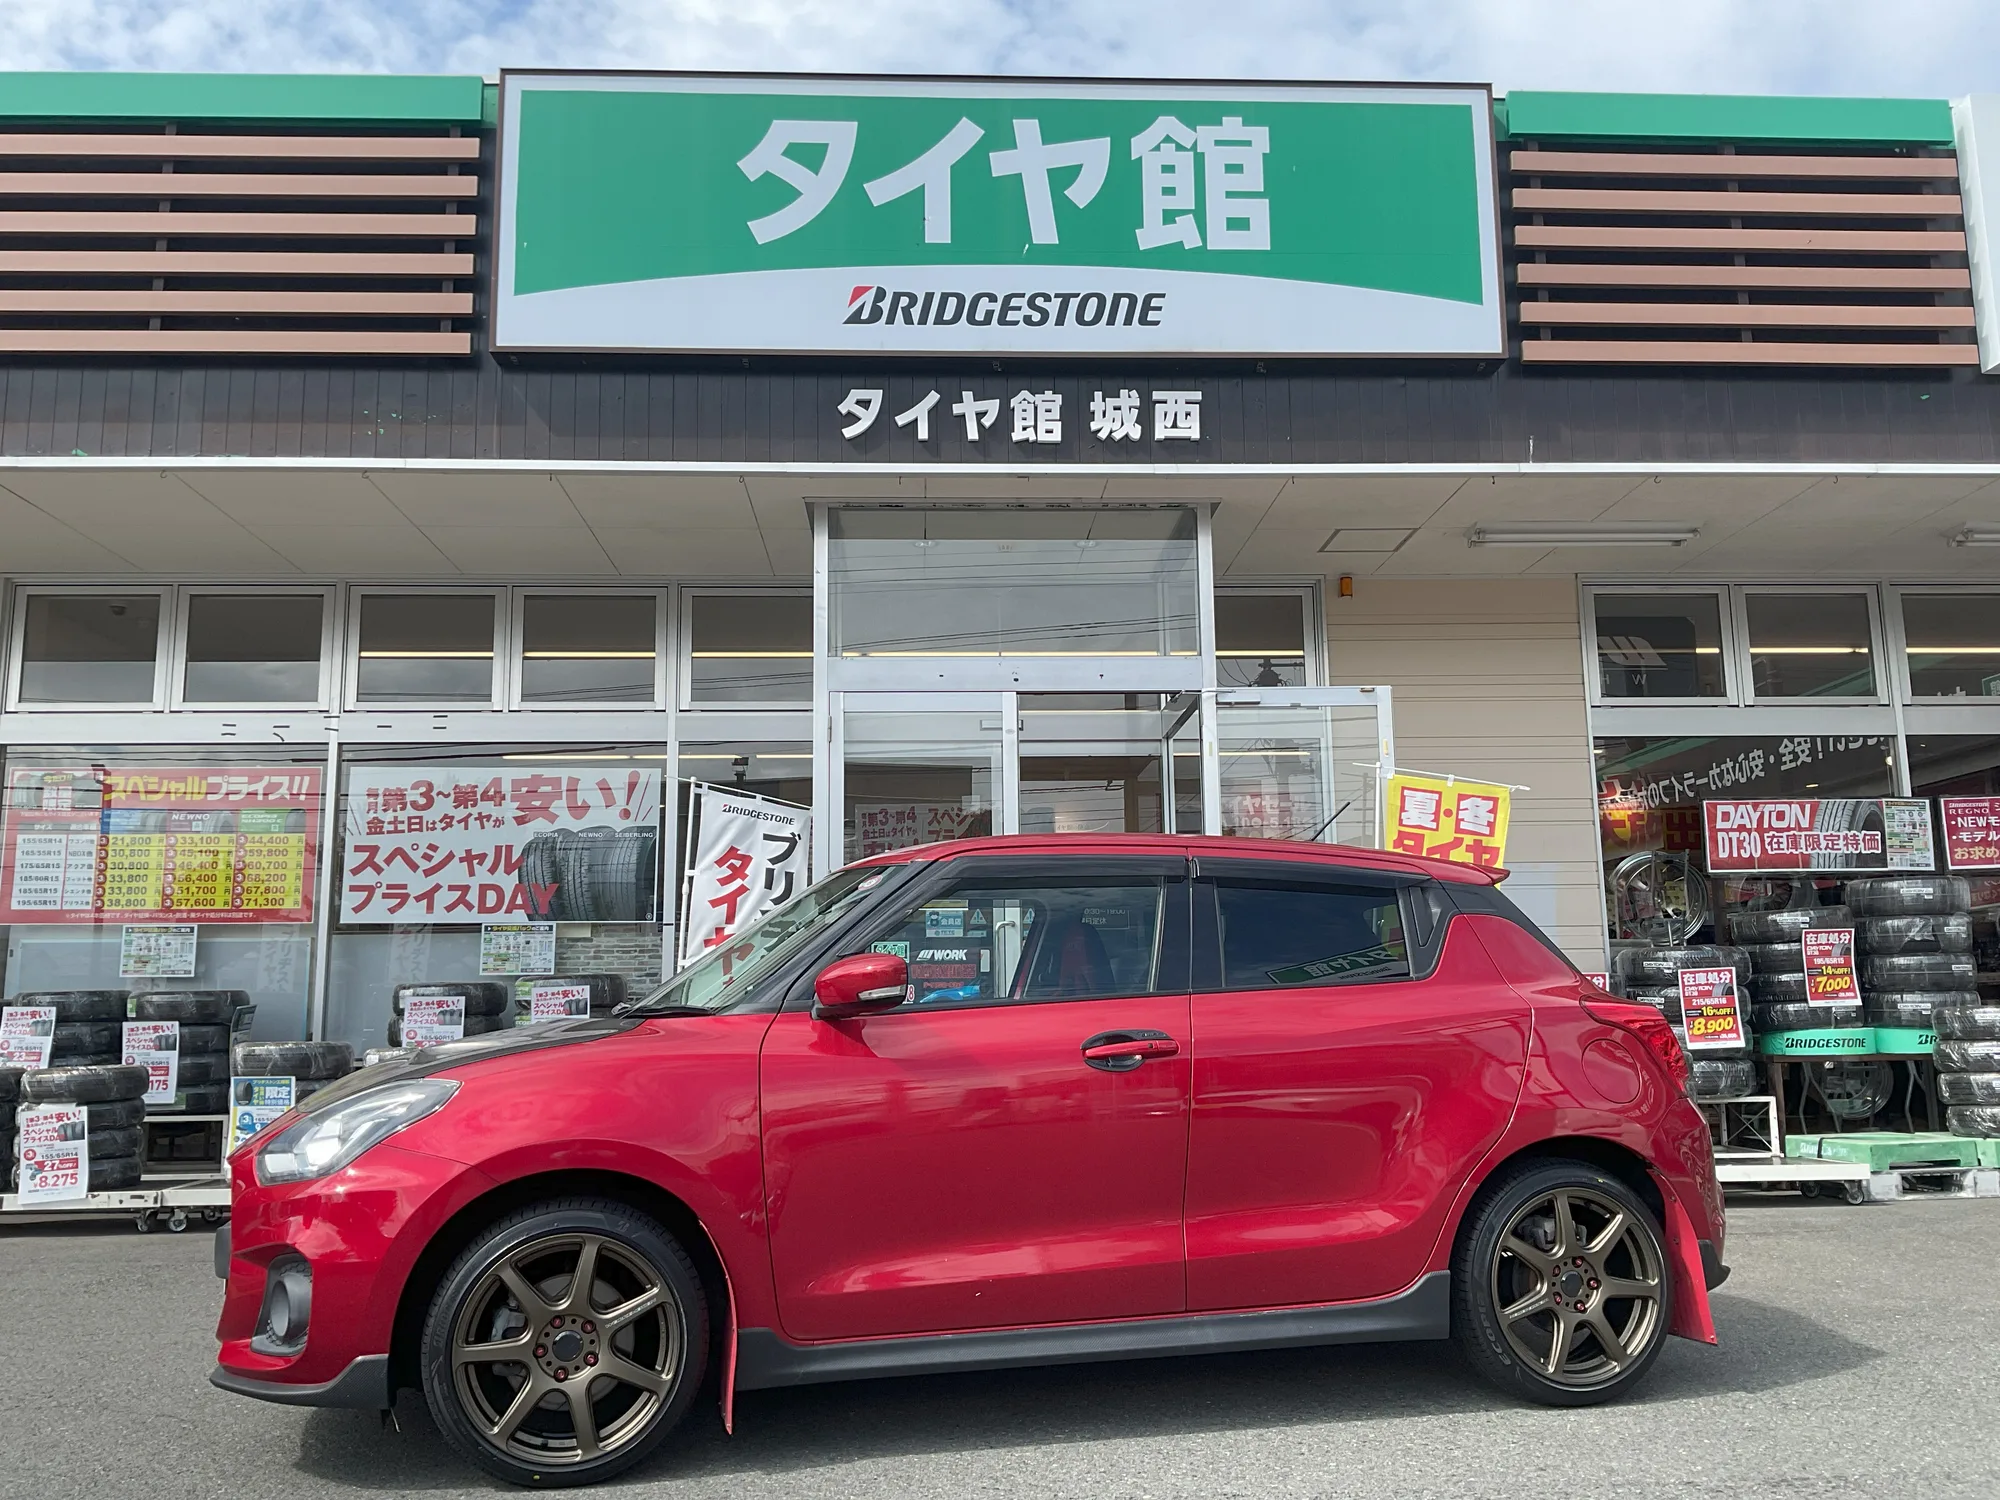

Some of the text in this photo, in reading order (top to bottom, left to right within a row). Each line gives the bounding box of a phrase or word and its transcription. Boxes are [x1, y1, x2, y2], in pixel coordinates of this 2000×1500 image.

[737, 114, 1271, 251] タイヤ館
[842, 285, 1166, 327] BRIDGESTONE
[837, 388, 1202, 443] タイヤ館 城西
[171, 813, 210, 821] NEWNO
[365, 811, 505, 836] 金土日はタイヤが
[722, 803, 795, 826] BRIDGESTONE
[1716, 804, 1810, 829] DAYTON
[1717, 831, 1761, 858] DT30
[1765, 831, 1882, 855] 在庫限定特価
[1954, 846, 2000, 860] お求め
[349, 842, 525, 878] スペシャル
[348, 881, 560, 915] プライスDAY
[1806, 932, 1851, 945] 在庫処分
[933, 949, 968, 960] WORK
[1682, 971, 1732, 985] 在庫処分
[1785, 1037, 1866, 1049] BRIDGESTONE
[265, 1086, 291, 1098] 限定
